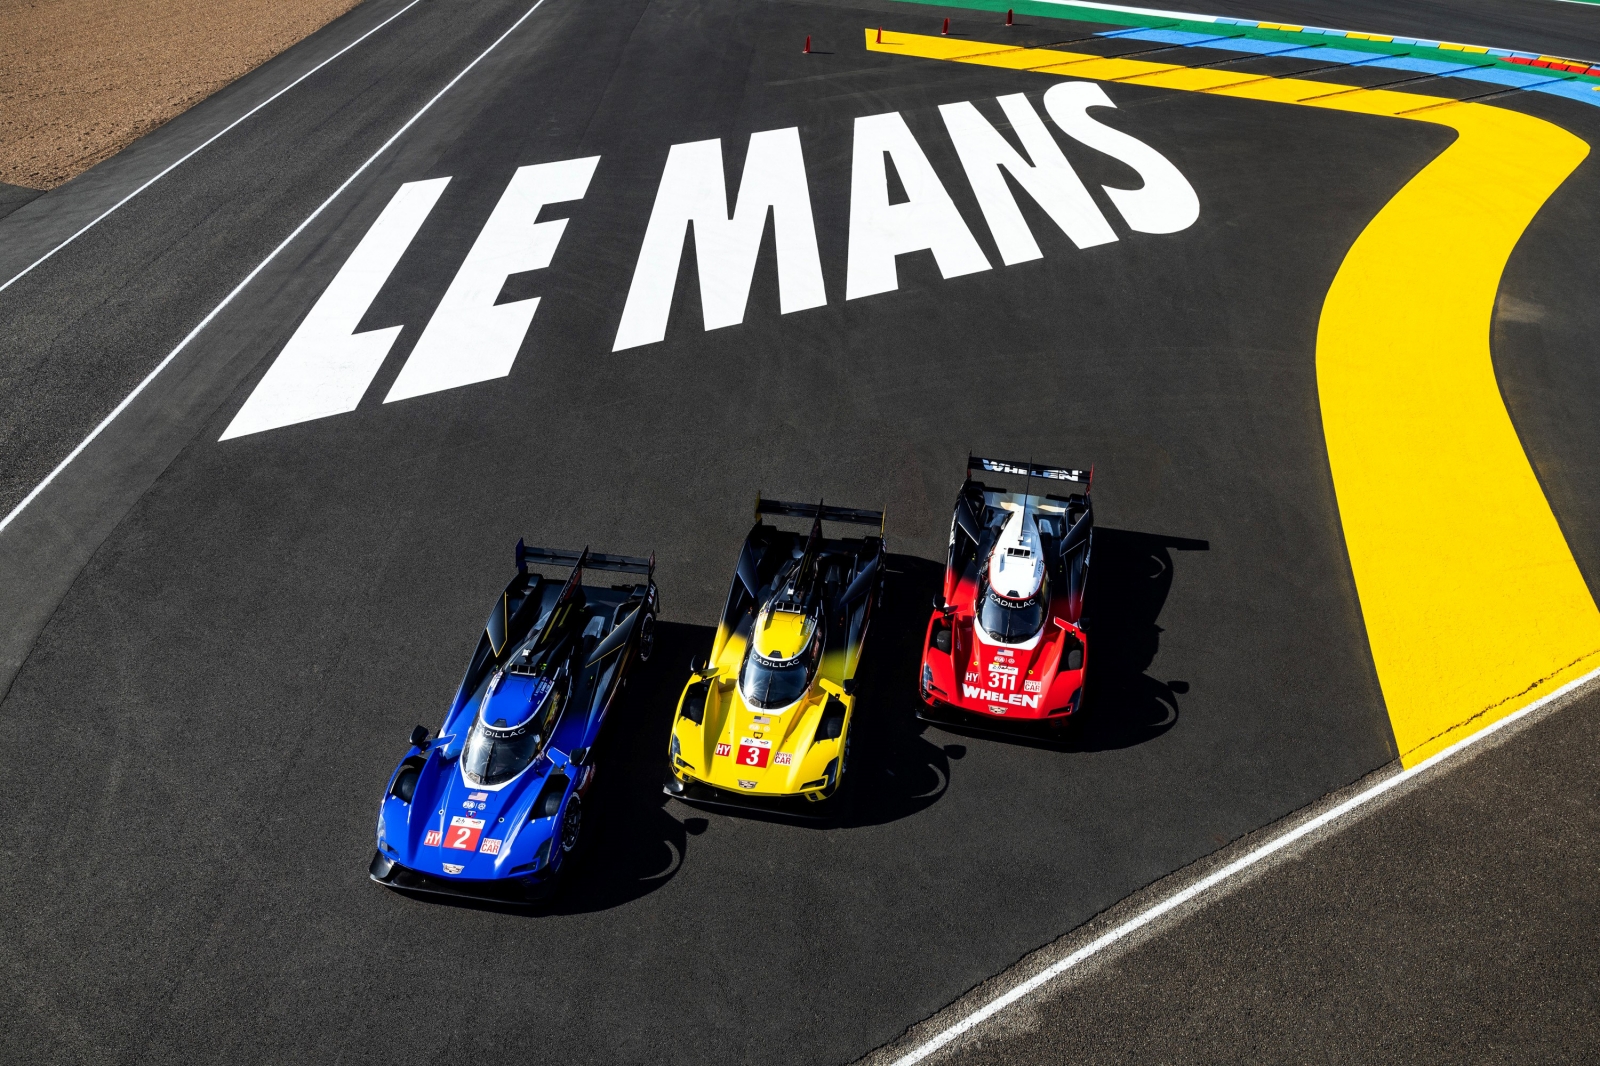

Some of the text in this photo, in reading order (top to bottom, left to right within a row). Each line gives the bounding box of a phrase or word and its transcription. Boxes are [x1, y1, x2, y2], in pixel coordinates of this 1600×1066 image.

[217, 81, 1200, 442] LE MANS
[982, 458, 1079, 482] WHELEN
[990, 593, 1036, 609] CADILLAC
[752, 653, 800, 668] CADILLAC
[965, 672, 979, 682] HY
[988, 672, 1017, 691] 311
[1024, 684, 1041, 692] CAR
[962, 683, 1039, 709] WHELEN
[716, 743, 731, 756] HY
[745, 747, 760, 766] 3
[774, 756, 792, 765] CAR
[425, 831, 440, 846] HY
[453, 827, 471, 849] 2
[481, 844, 499, 854] CAR
